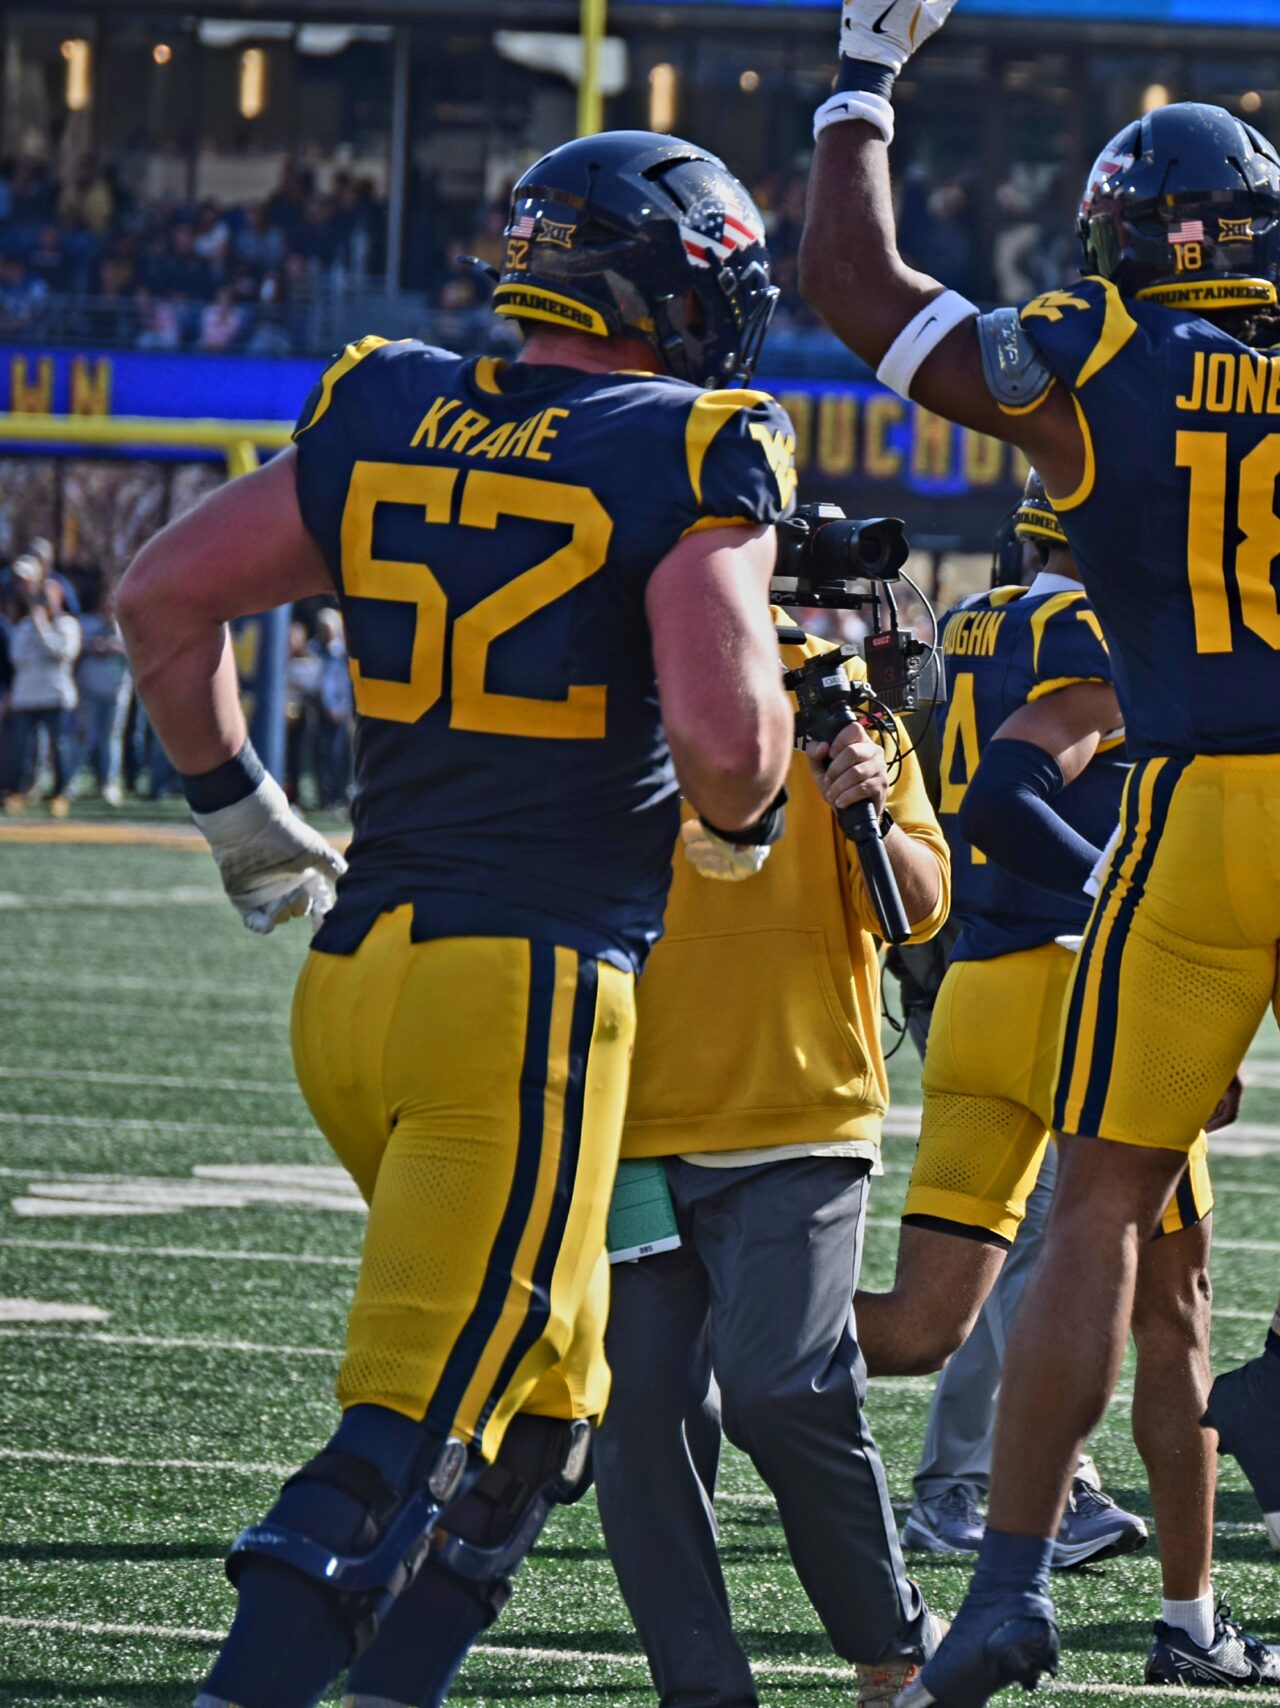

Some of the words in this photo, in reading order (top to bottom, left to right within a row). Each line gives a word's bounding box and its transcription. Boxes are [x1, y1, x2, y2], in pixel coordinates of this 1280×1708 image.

[506, 239, 529, 270] 52
[1174, 243, 1202, 273] 18
[340, 460, 614, 740] 52
